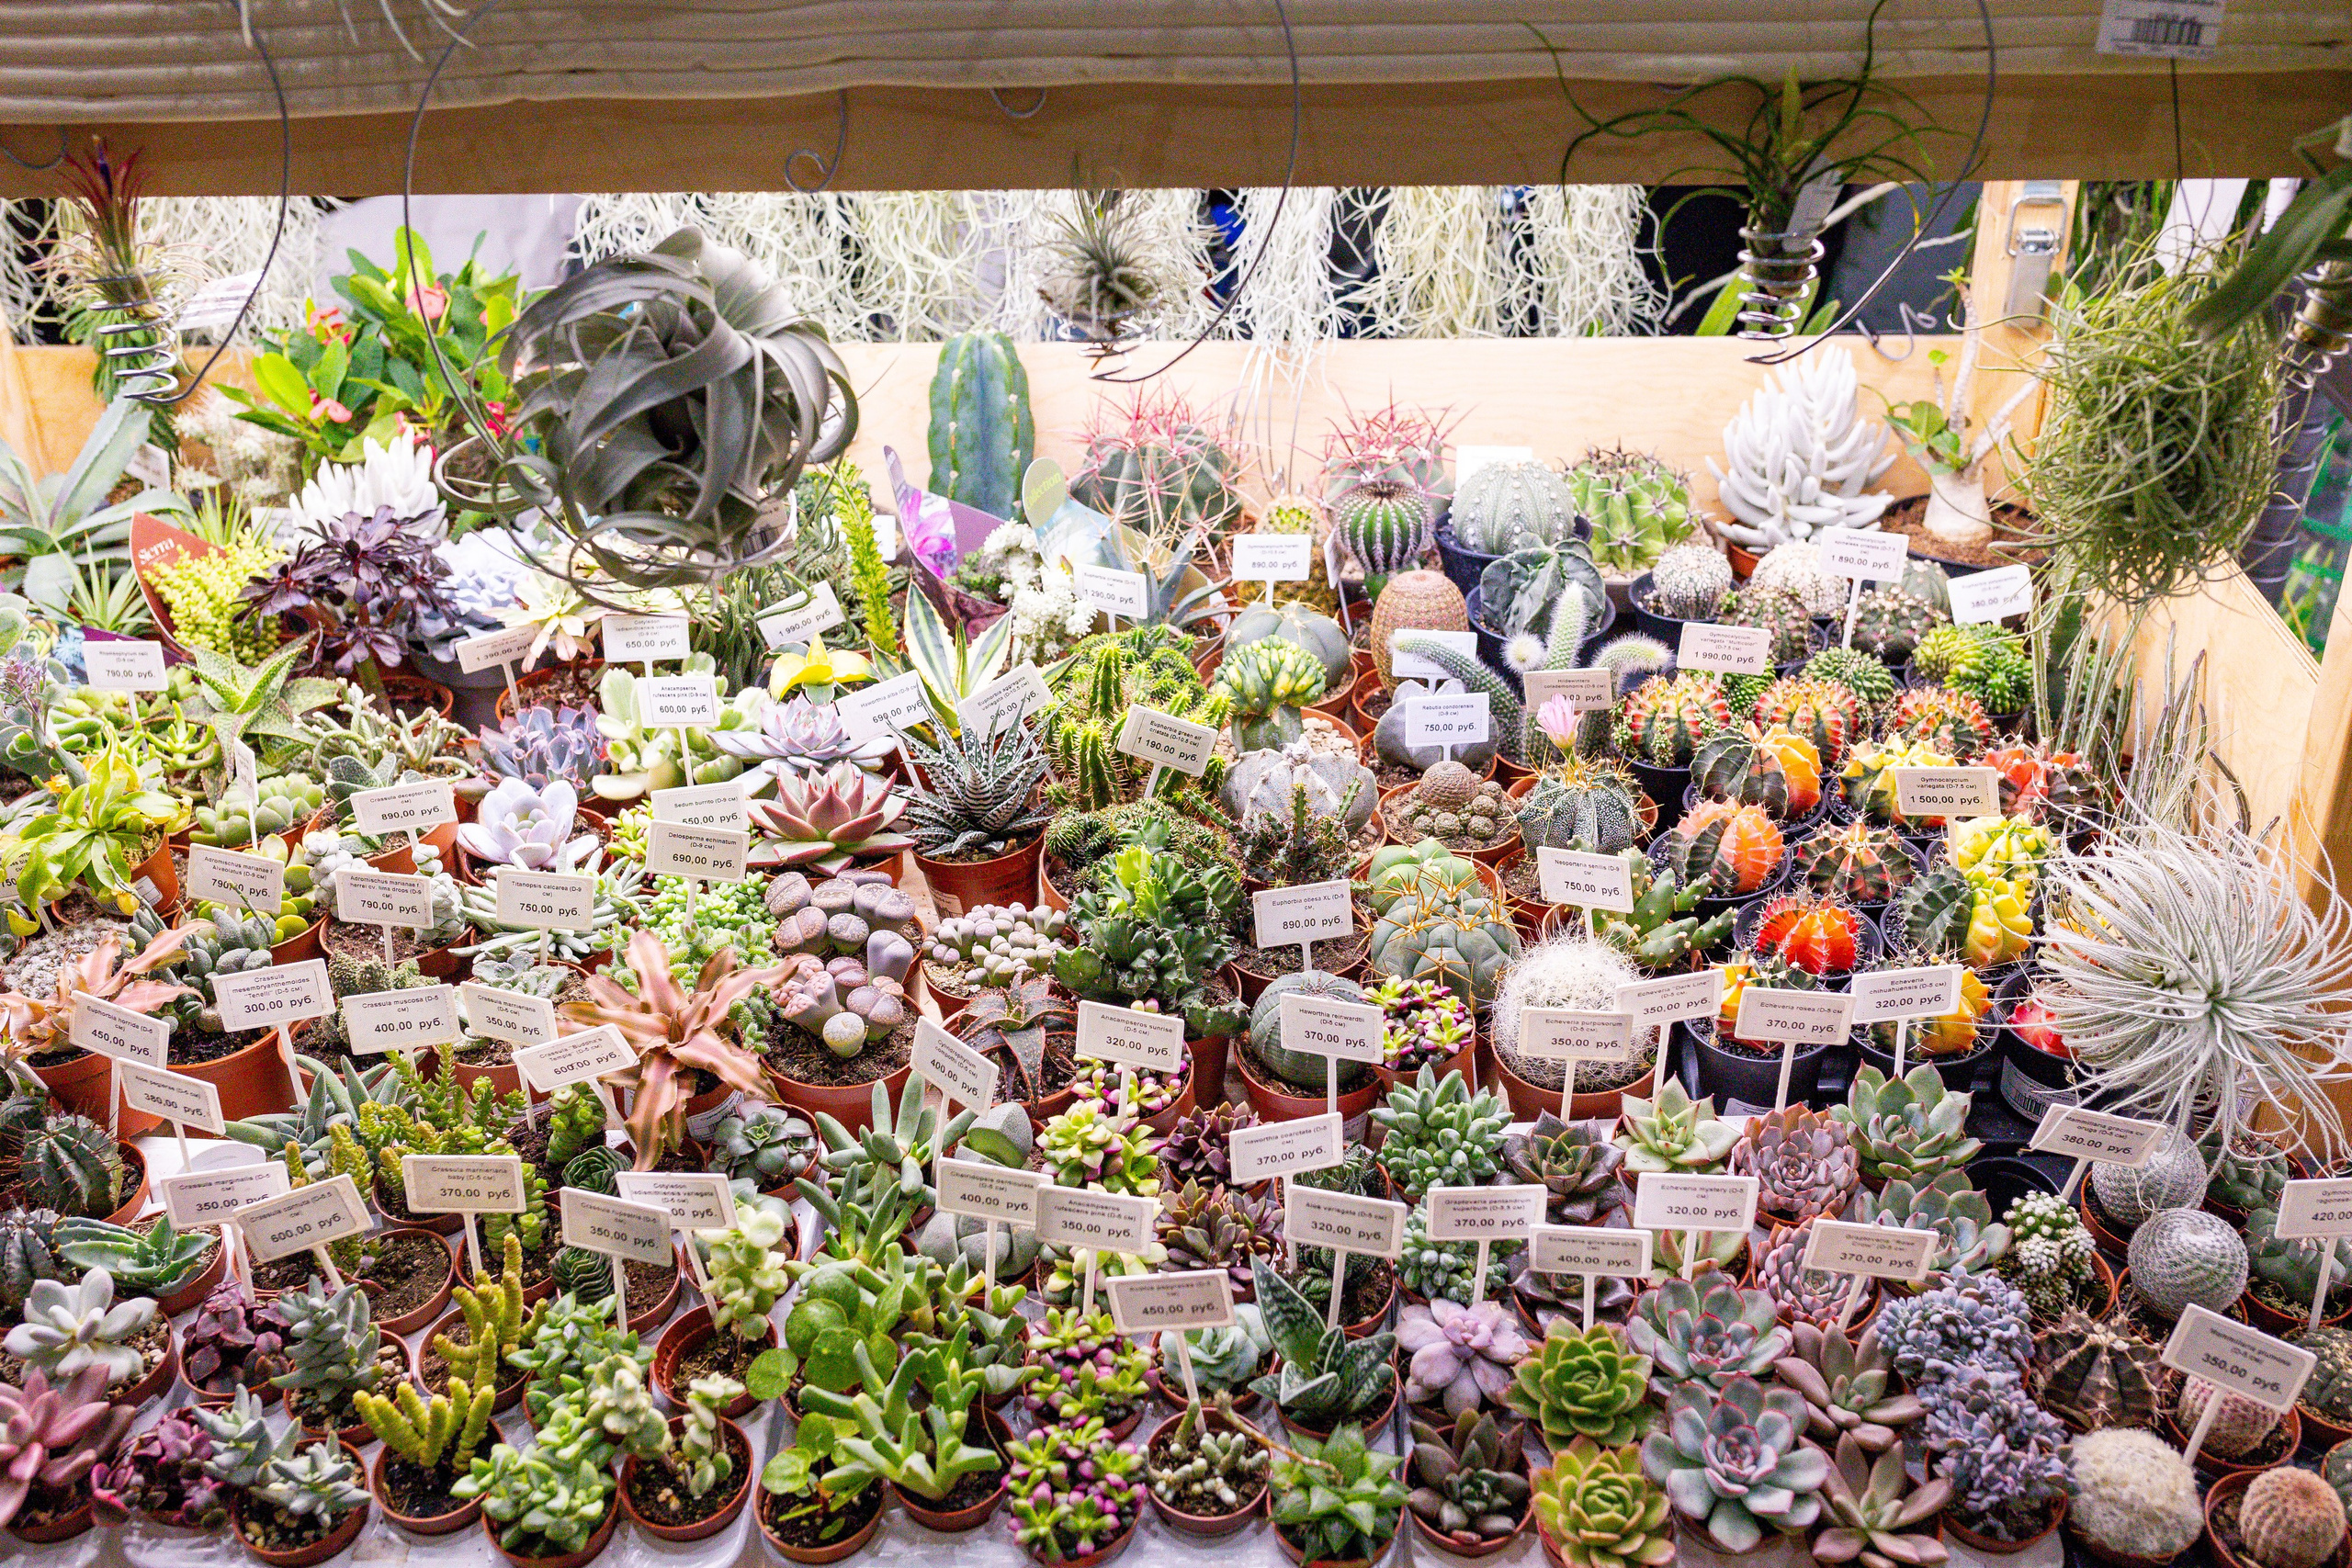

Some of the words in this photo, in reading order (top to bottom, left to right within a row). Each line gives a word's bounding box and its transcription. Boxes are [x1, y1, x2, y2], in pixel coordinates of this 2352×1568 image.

[138, 537, 175, 565] Sierra
[1091, 590, 1116, 601] 290,00
[1119, 596, 1136, 605] руб.
[785, 618, 812, 635] 990,00
[815, 611, 833, 622] руб.
[625, 639, 655, 649] 650,00
[660, 638, 680, 648] руб.
[1702, 651, 1733, 661] 990,00
[1736, 656, 1757, 664] руб.
[106, 670, 133, 678] 790,00
[137, 671, 156, 680] руб.
[977, 690, 1002, 707] Euphorbia
[1001, 676, 1026, 694] aggregata
[1585, 694, 1605, 703] руб.
[860, 695, 887, 708] Haworthia
[659, 705, 687, 714] 600,00
[691, 705, 709, 715] руб.
[872, 707, 902, 724] 690,00
[906, 700, 927, 714] руб
[1149, 720, 1178, 734] Euphorbia
[1177, 730, 1193, 739] green
[1424, 723, 1453, 732] 750,00
[1457, 723, 1476, 733] руб.
[1146, 739, 1175, 755] 190,00
[1178, 751, 1198, 763] руб.
[397, 791, 424, 799] deceptor
[1919, 795, 1954, 805] 500,00
[1960, 795, 1984, 806] руб.
[381, 809, 415, 820] 890,00
[420, 806, 443, 817] руб.
[668, 832, 705, 841] Delosperma
[705, 837, 737, 845] echinatum
[204, 856, 242, 869] Adromischus
[243, 864, 269, 874] marianae
[673, 853, 707, 865] 690,00
[712, 859, 735, 869] руб.
[212, 865, 243, 875] Alveolatus
[211, 878, 244, 893] 790,0
[512, 881, 542, 889] Titanopsis
[1564, 881, 1596, 893] 750,00
[1601, 886, 1623, 897] руб.
[360, 900, 394, 911] 790,00
[399, 905, 421, 915] руб.
[1272, 898, 1303, 907] Euphorbia
[519, 903, 553, 914] 750,00
[559, 908, 581, 918] руб.
[1283, 919, 1317, 930] 890,00
[1321, 917, 1343, 928] руб.
[254, 974, 285, 983] Crassula
[1890, 977, 1925, 986] Echeveria
[1869, 985, 1918, 995] chihuahuensis
[243, 1000, 283, 1014] 300,00
[289, 997, 315, 1008] руб.
[361, 1000, 392, 1009] Crassula
[393, 997, 424, 1005] muscosa
[1643, 1002, 1680, 1015] 350,00
[1686, 997, 1711, 1009] руб.
[1759, 1001, 1794, 1010] Echeveria
[1875, 997, 1914, 1009] 320,00
[1919, 994, 1944, 1006] руб.
[86, 1005, 117, 1021] Euphorbia
[118, 1017, 140, 1030] horrida
[1101, 1014, 1148, 1028] Anacampseros
[1148, 1024, 1173, 1033] sunrise
[374, 1021, 413, 1032] 400,00
[419, 1019, 444, 1031] руб.
[485, 1016, 517, 1031] 350,00
[522, 1026, 543, 1036] руб.
[1766, 1019, 1805, 1031] 370,00
[1811, 1024, 1837, 1033] руб.
[91, 1029, 125, 1047] 450,00
[130, 1044, 153, 1057] руб.
[1105, 1036, 1142, 1051] 320,00
[1148, 1046, 1170, 1056] руб.
[1305, 1031, 1340, 1043] 370,00
[1345, 1038, 1369, 1048] руб.
[1551, 1038, 1589, 1047] 350,00
[1596, 1040, 1621, 1050] руб.
[930, 1059, 958, 1082] 400,00
[961, 1081, 979, 1099] руб.
[1257, 1151, 1295, 1166] 370,00
[1301, 1146, 1327, 1159] руб.
[440, 1189, 481, 1198] 370,00
[487, 1190, 514, 1200] руб.
[196, 1198, 239, 1212] 350,00
[691, 1209, 718, 1219] руб.
[1667, 1206, 1708, 1216] 320,00
[1713, 1209, 1741, 1219] руб.
[2312, 1211, 2352, 1222] 420,00
[1061, 1221, 1102, 1234] 350,00
[1107, 1228, 1134, 1238] руб.
[1454, 1218, 1495, 1227] 370,00
[1501, 1218, 1528, 1228] руб.
[590, 1225, 628, 1242] 350,00
[633, 1237, 659, 1249] руб.
[1311, 1222, 1351, 1235] 320,00
[1358, 1230, 1384, 1241] руб.
